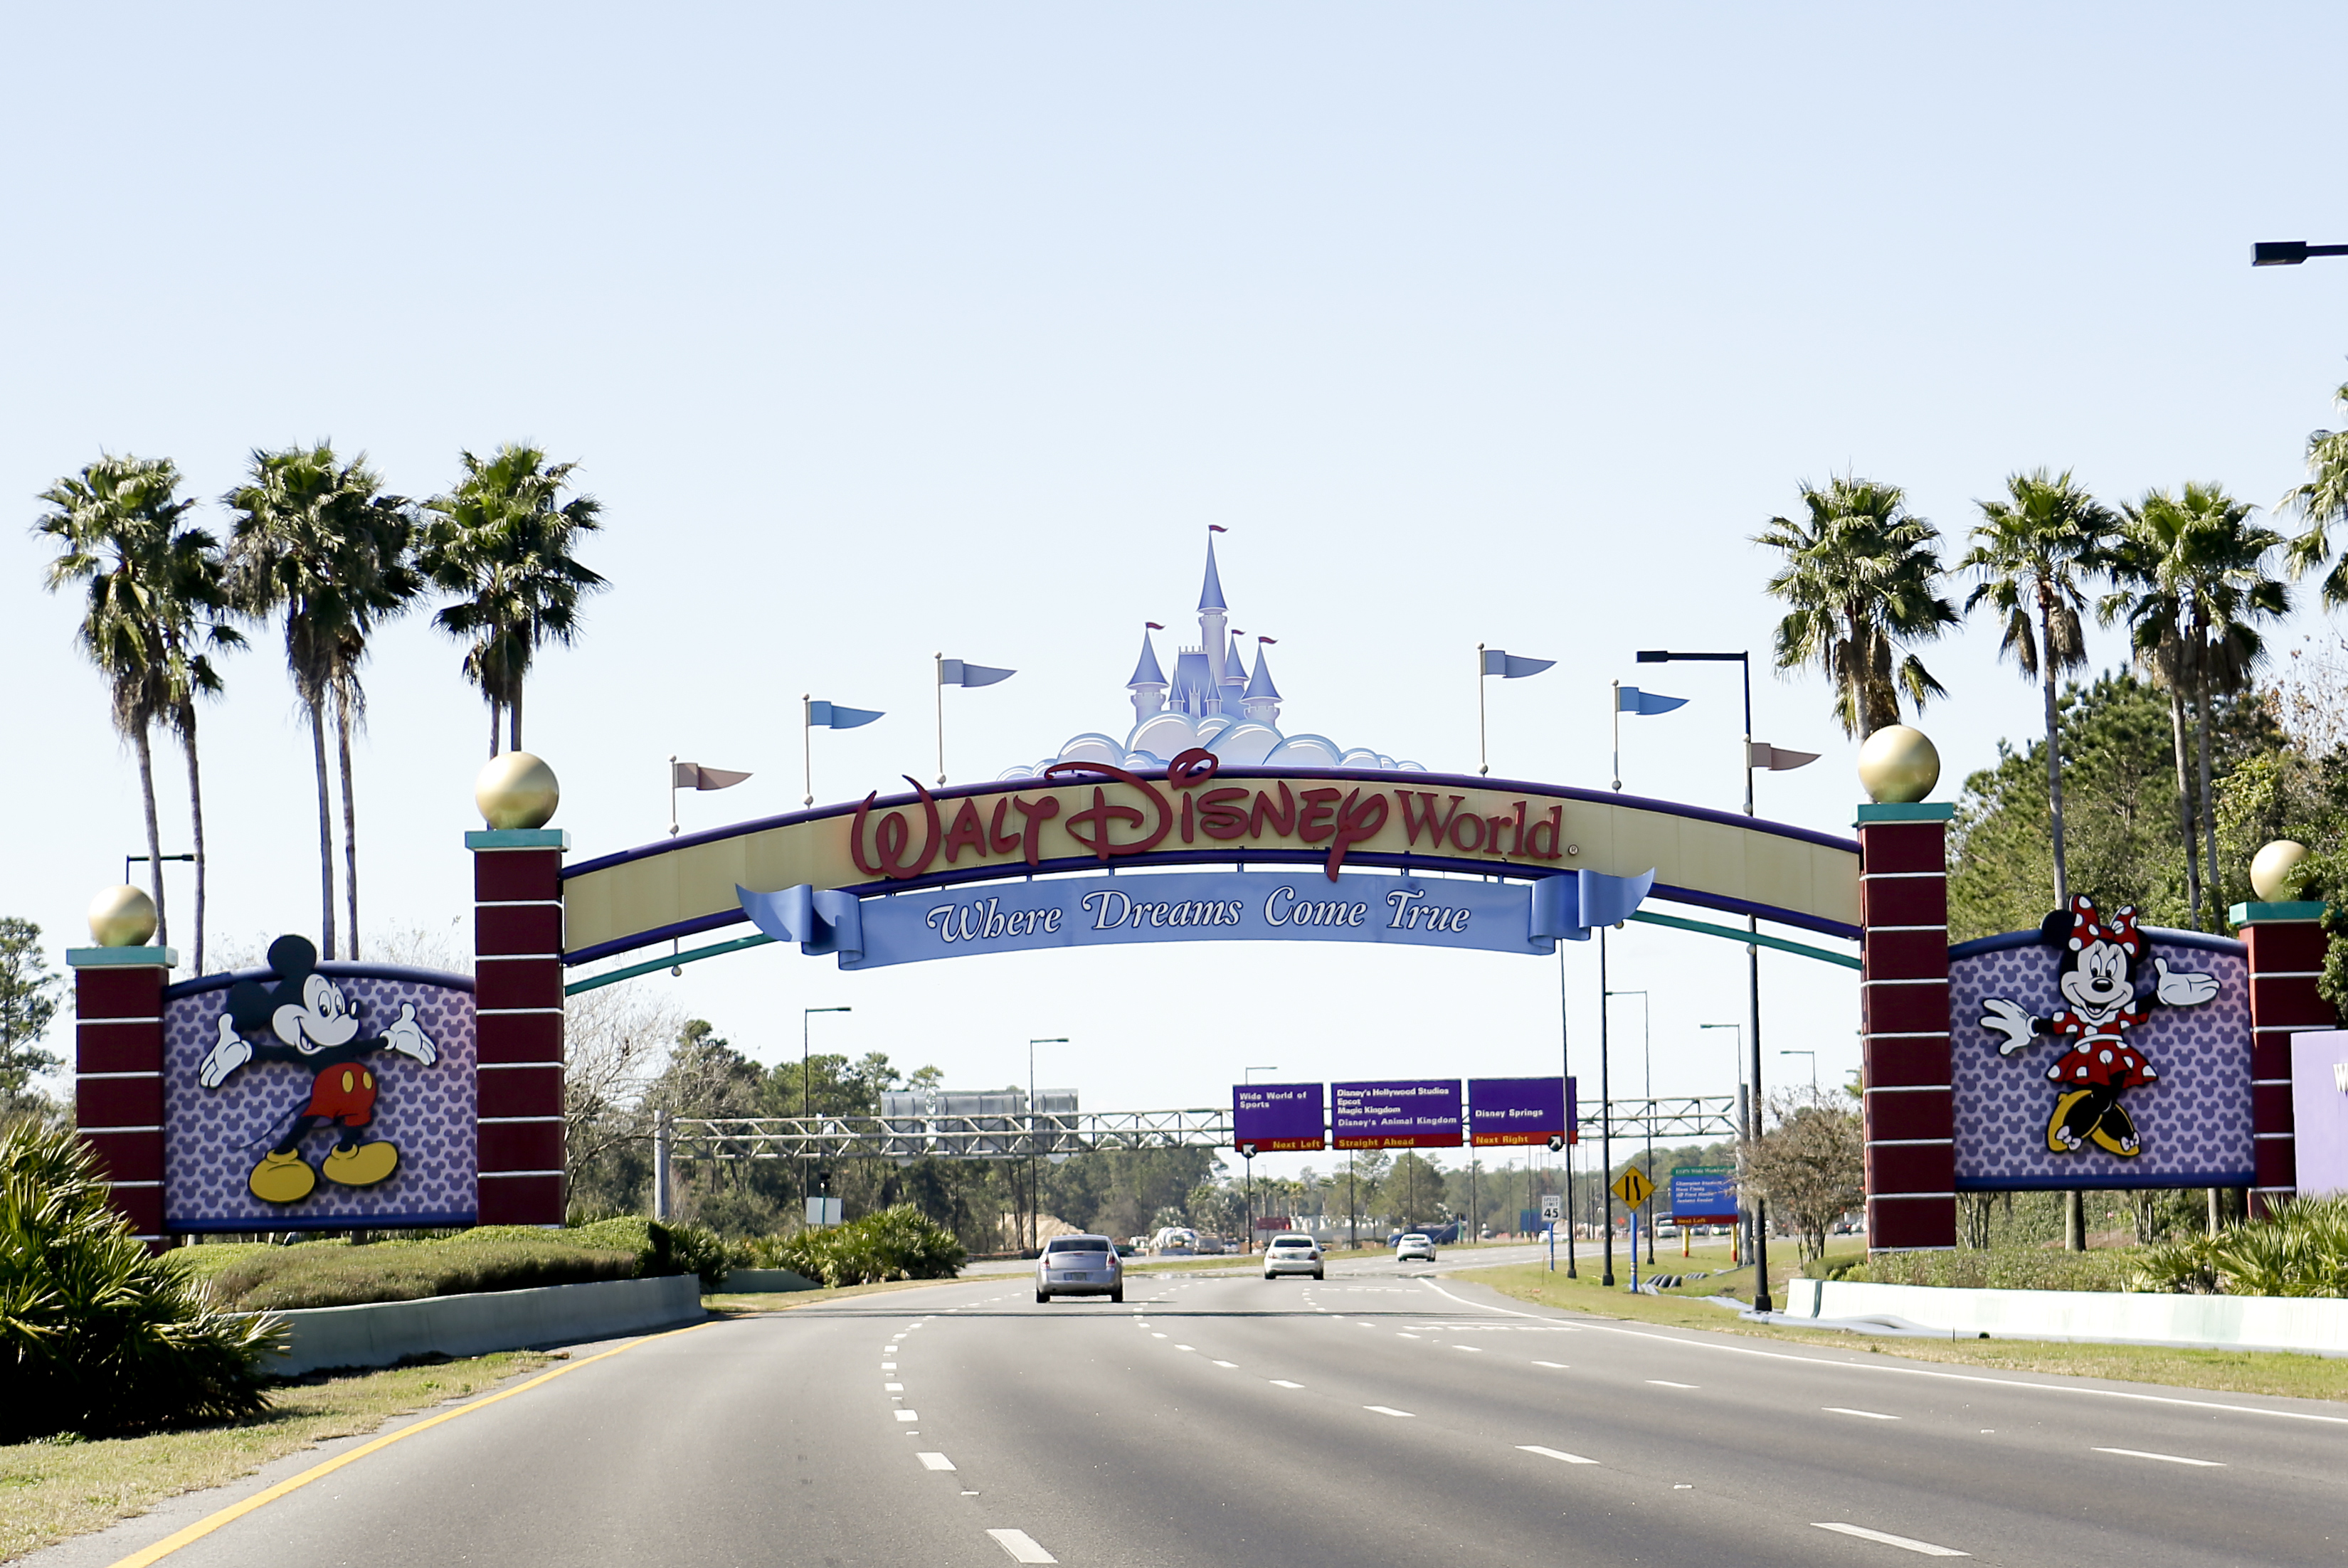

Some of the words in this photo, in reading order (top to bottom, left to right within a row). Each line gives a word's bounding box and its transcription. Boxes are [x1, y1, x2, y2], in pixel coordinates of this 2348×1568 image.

[1394, 788, 1562, 859] World
[926, 896, 1063, 943] Where
[1082, 889, 1244, 931] Dreams
[1263, 885, 1368, 927] Come
[1385, 888, 1471, 933] True
[1239, 1092, 1262, 1101] Wide
[1266, 1091, 1294, 1100] World
[1297, 1091, 1307, 1099] of
[1337, 1088, 1371, 1098] Disney's
[1373, 1087, 1416, 1098] Hollywood
[1239, 1101, 1270, 1110] Sports
[1338, 1107, 1363, 1116] Magic
[1364, 1106, 1401, 1115] Kingdom
[1475, 1109, 1506, 1118] Disney
[1508, 1108, 1544, 1118] Springs
[1338, 1119, 1377, 1128] Disney's
[1417, 1116, 1457, 1125] Kingdom
[1338, 1139, 1379, 1148] Straight
[1383, 1138, 1414, 1146] Ahead
[1476, 1135, 1498, 1144] Next
[1502, 1135, 1528, 1144] Right
[1543, 1208, 1558, 1218] 45
